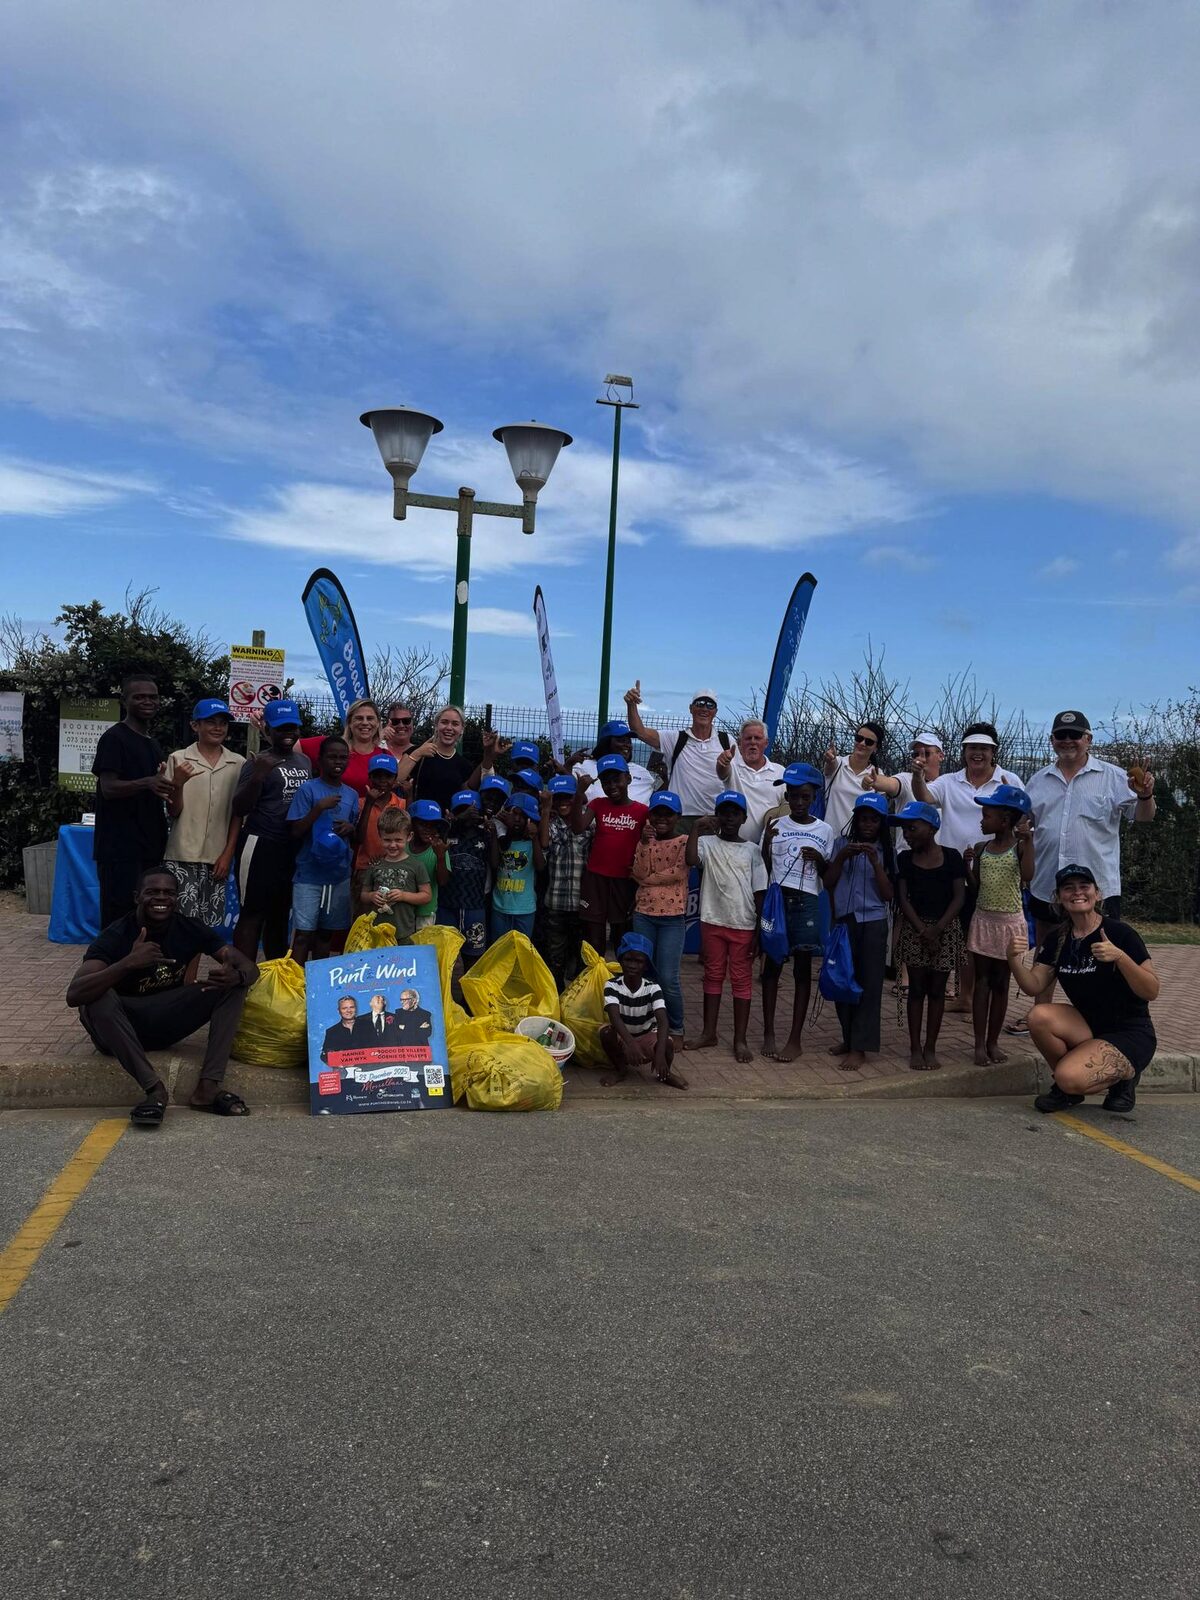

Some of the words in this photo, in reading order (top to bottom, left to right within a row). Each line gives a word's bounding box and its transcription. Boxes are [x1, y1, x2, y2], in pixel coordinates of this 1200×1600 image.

[232, 646, 273, 656] WARNING
[98, 700, 110, 708] UP
[279, 767, 309, 779] Relay
[602, 813, 638, 830] identity
[329, 963, 370, 987] Punt
[376, 958, 417, 979] Wind
